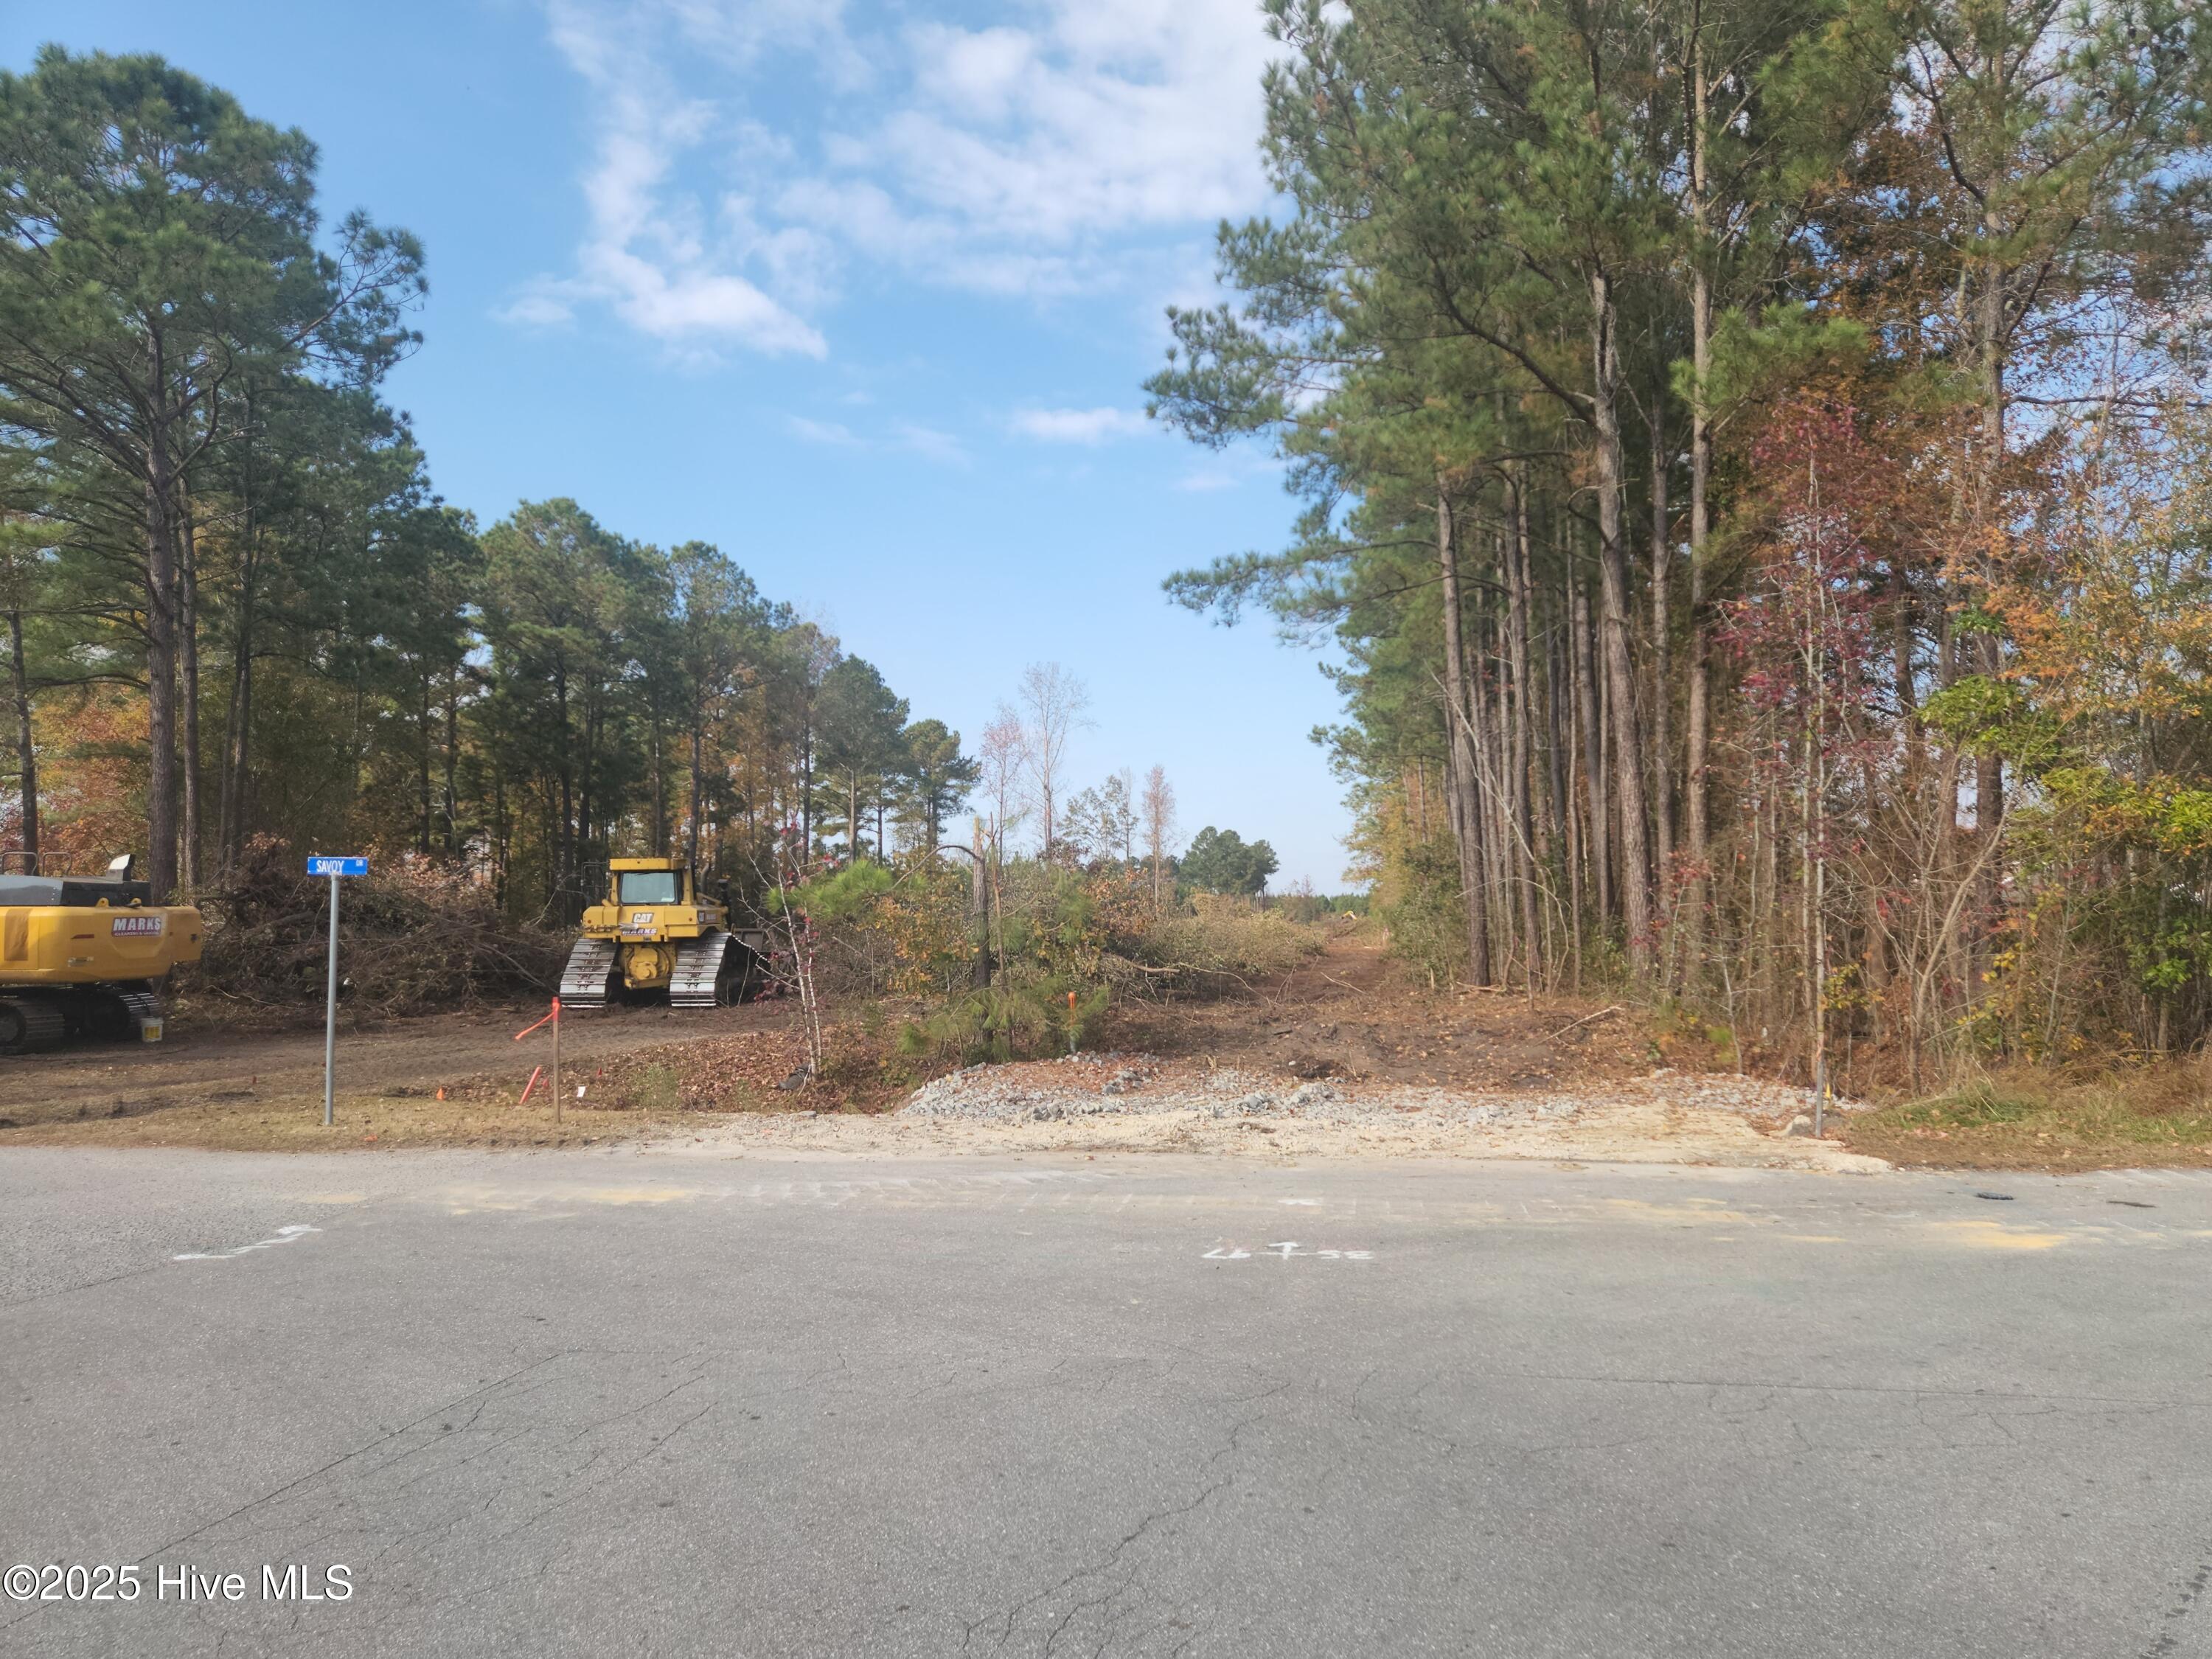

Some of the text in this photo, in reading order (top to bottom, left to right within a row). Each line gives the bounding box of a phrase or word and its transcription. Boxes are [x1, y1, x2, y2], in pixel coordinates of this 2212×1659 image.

[316, 860, 344, 873] SAVOY
[633, 913, 653, 922] CAT
[113, 918, 161, 931] MARKS
